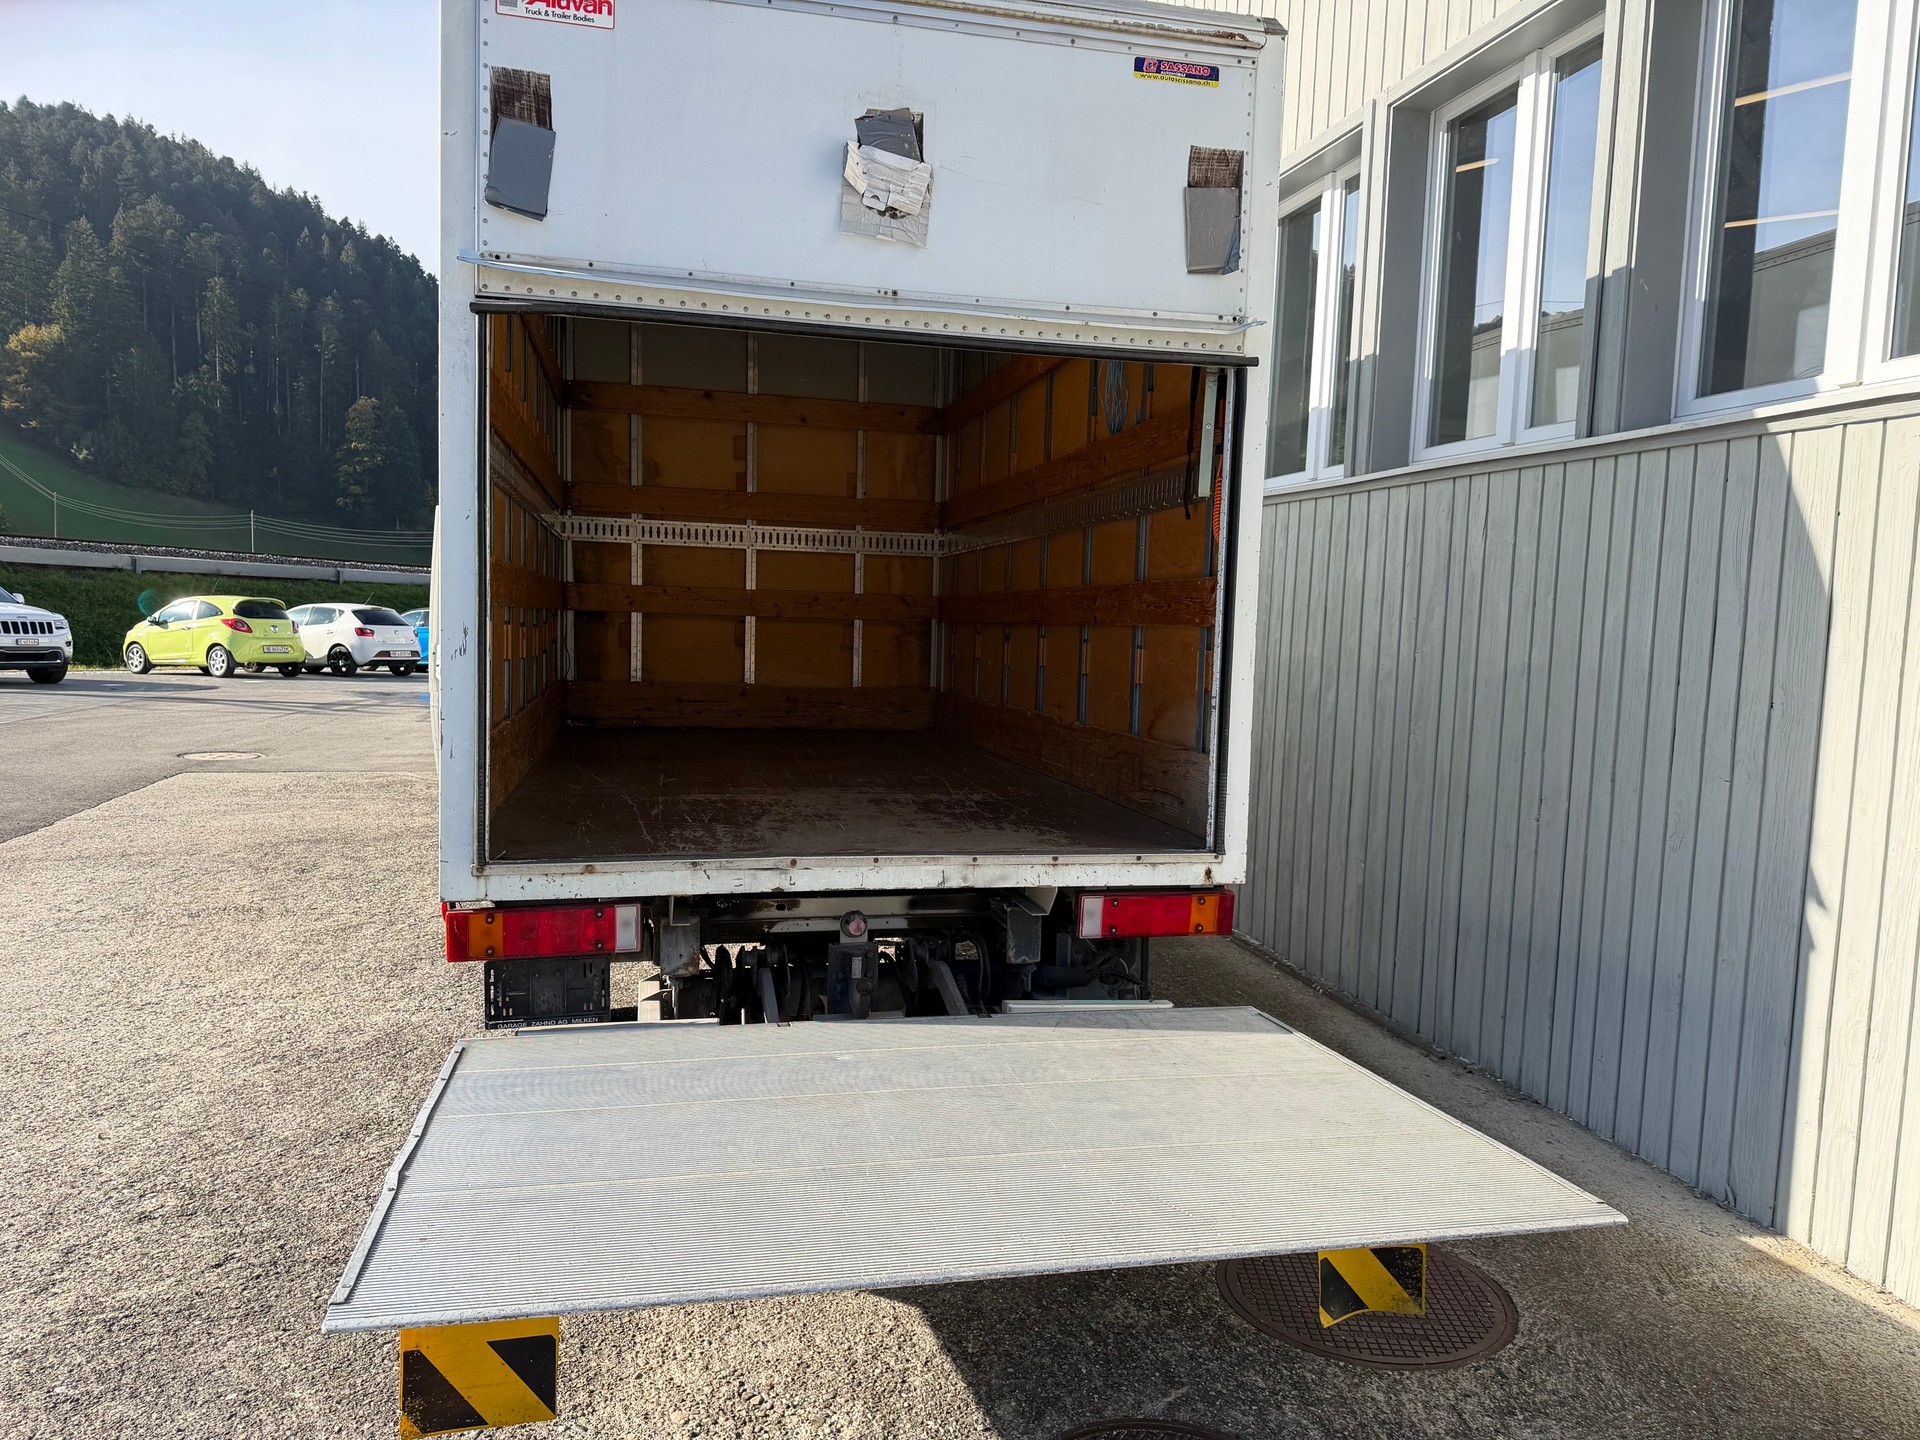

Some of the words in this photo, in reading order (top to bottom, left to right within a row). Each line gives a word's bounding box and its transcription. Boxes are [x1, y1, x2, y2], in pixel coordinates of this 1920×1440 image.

[524, 7, 543, 16] Truck
[544, 9, 550, 17] &
[551, 10, 571, 20] Trailer
[573, 14, 595, 23] Bodies
[1161, 61, 1210, 76] SASSANO
[497, 1021, 528, 1029] GARAGE
